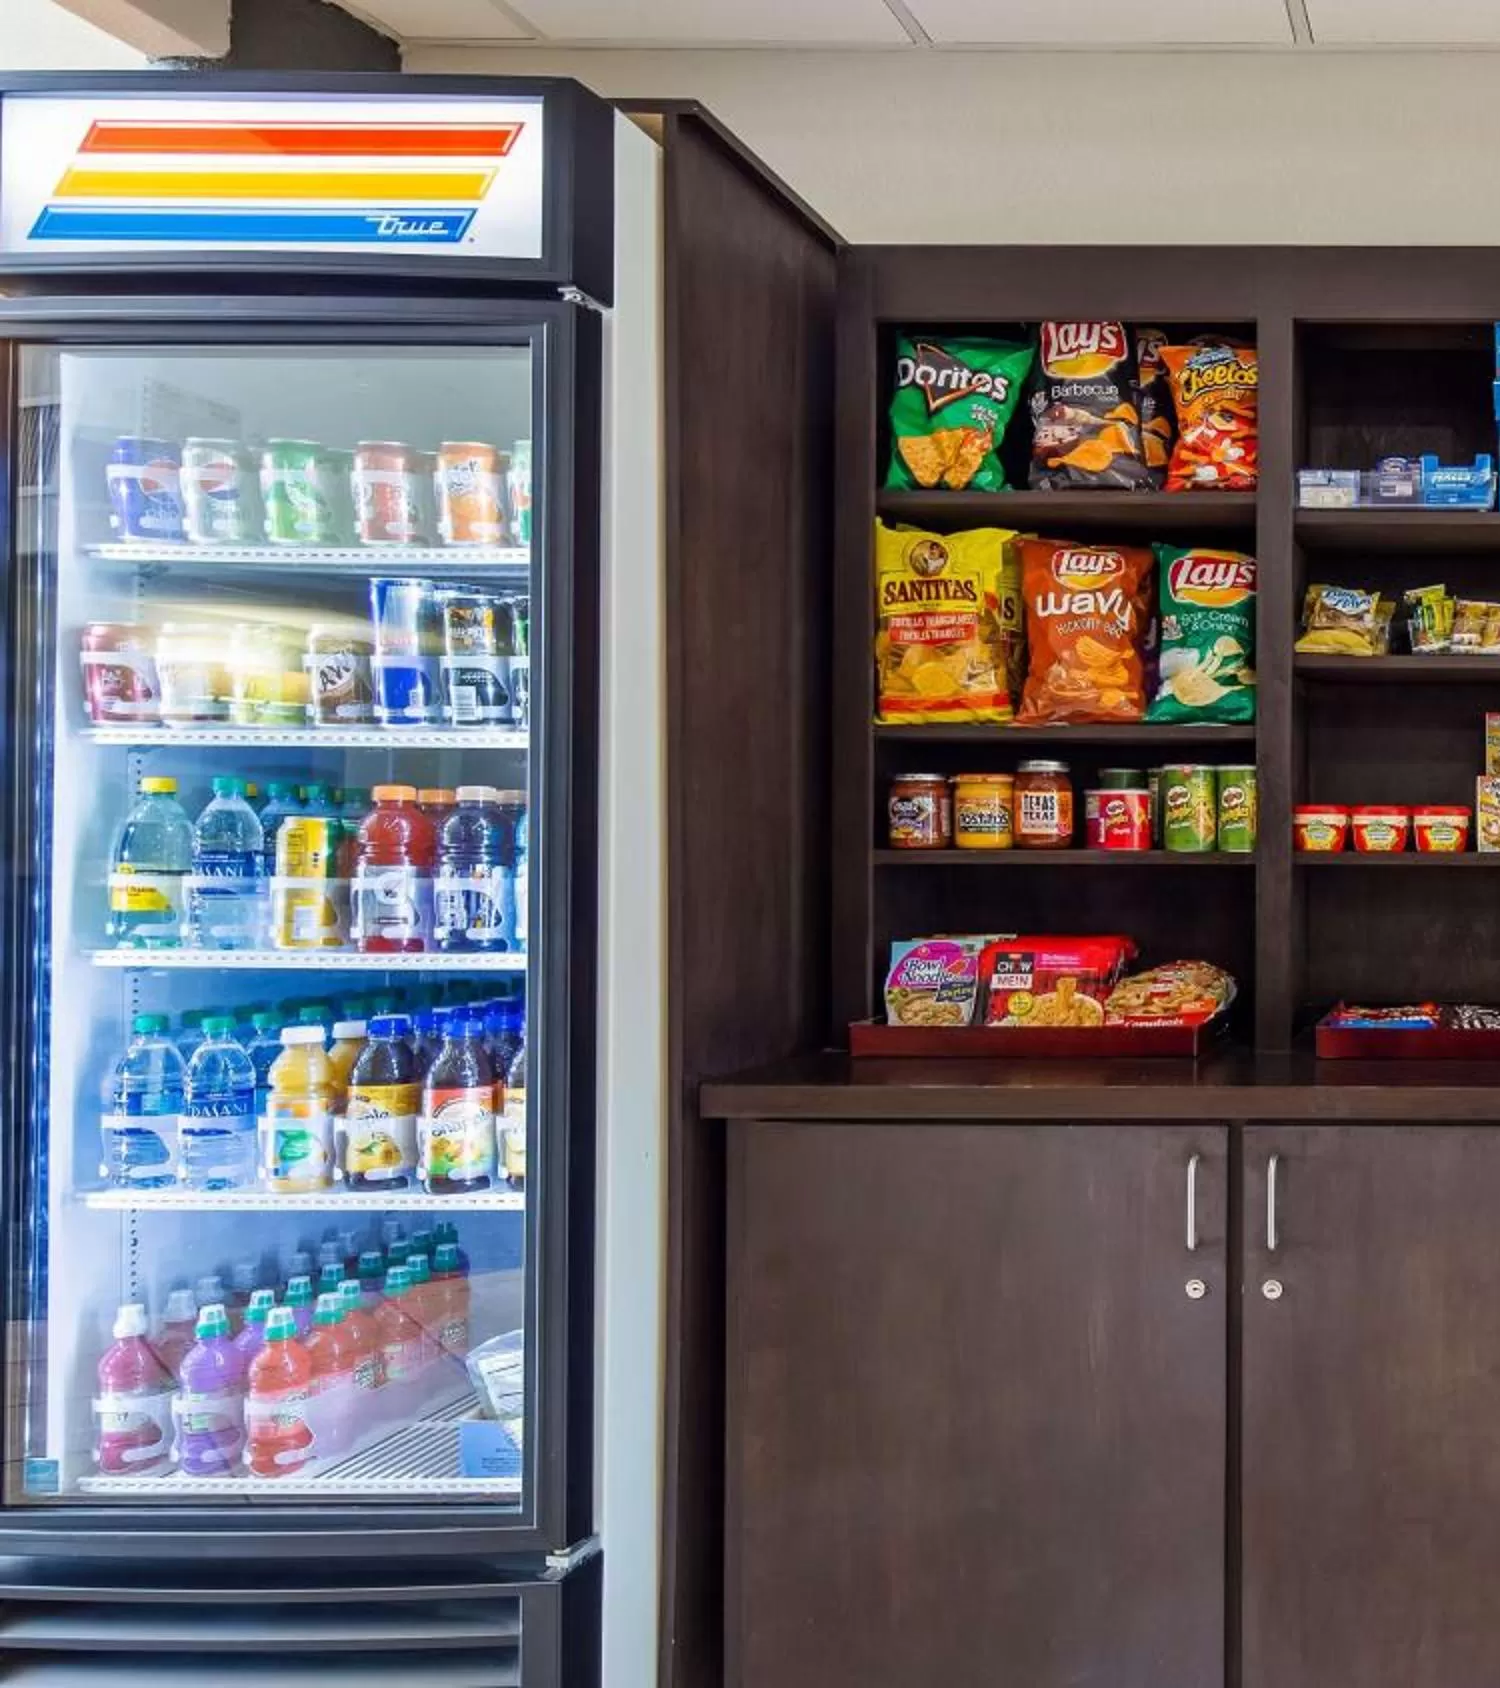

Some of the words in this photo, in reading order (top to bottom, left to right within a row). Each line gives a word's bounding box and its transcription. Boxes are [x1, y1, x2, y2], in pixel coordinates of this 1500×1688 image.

[365, 213, 449, 236] true
[897, 358, 1009, 401] Doritos
[1176, 361, 1257, 402] Cheetos
[1060, 551, 1118, 577] Lay's
[1175, 558, 1256, 591] Lay's
[883, 577, 978, 605] SANTITAS
[1036, 588, 1133, 631] wavy
[1023, 795, 1055, 811] TEXAS
[1023, 811, 1055, 821] TEXAS
[905, 957, 947, 974] Bowl
[997, 974, 1030, 988] MEIN
[189, 1102, 248, 1118] DASANI
